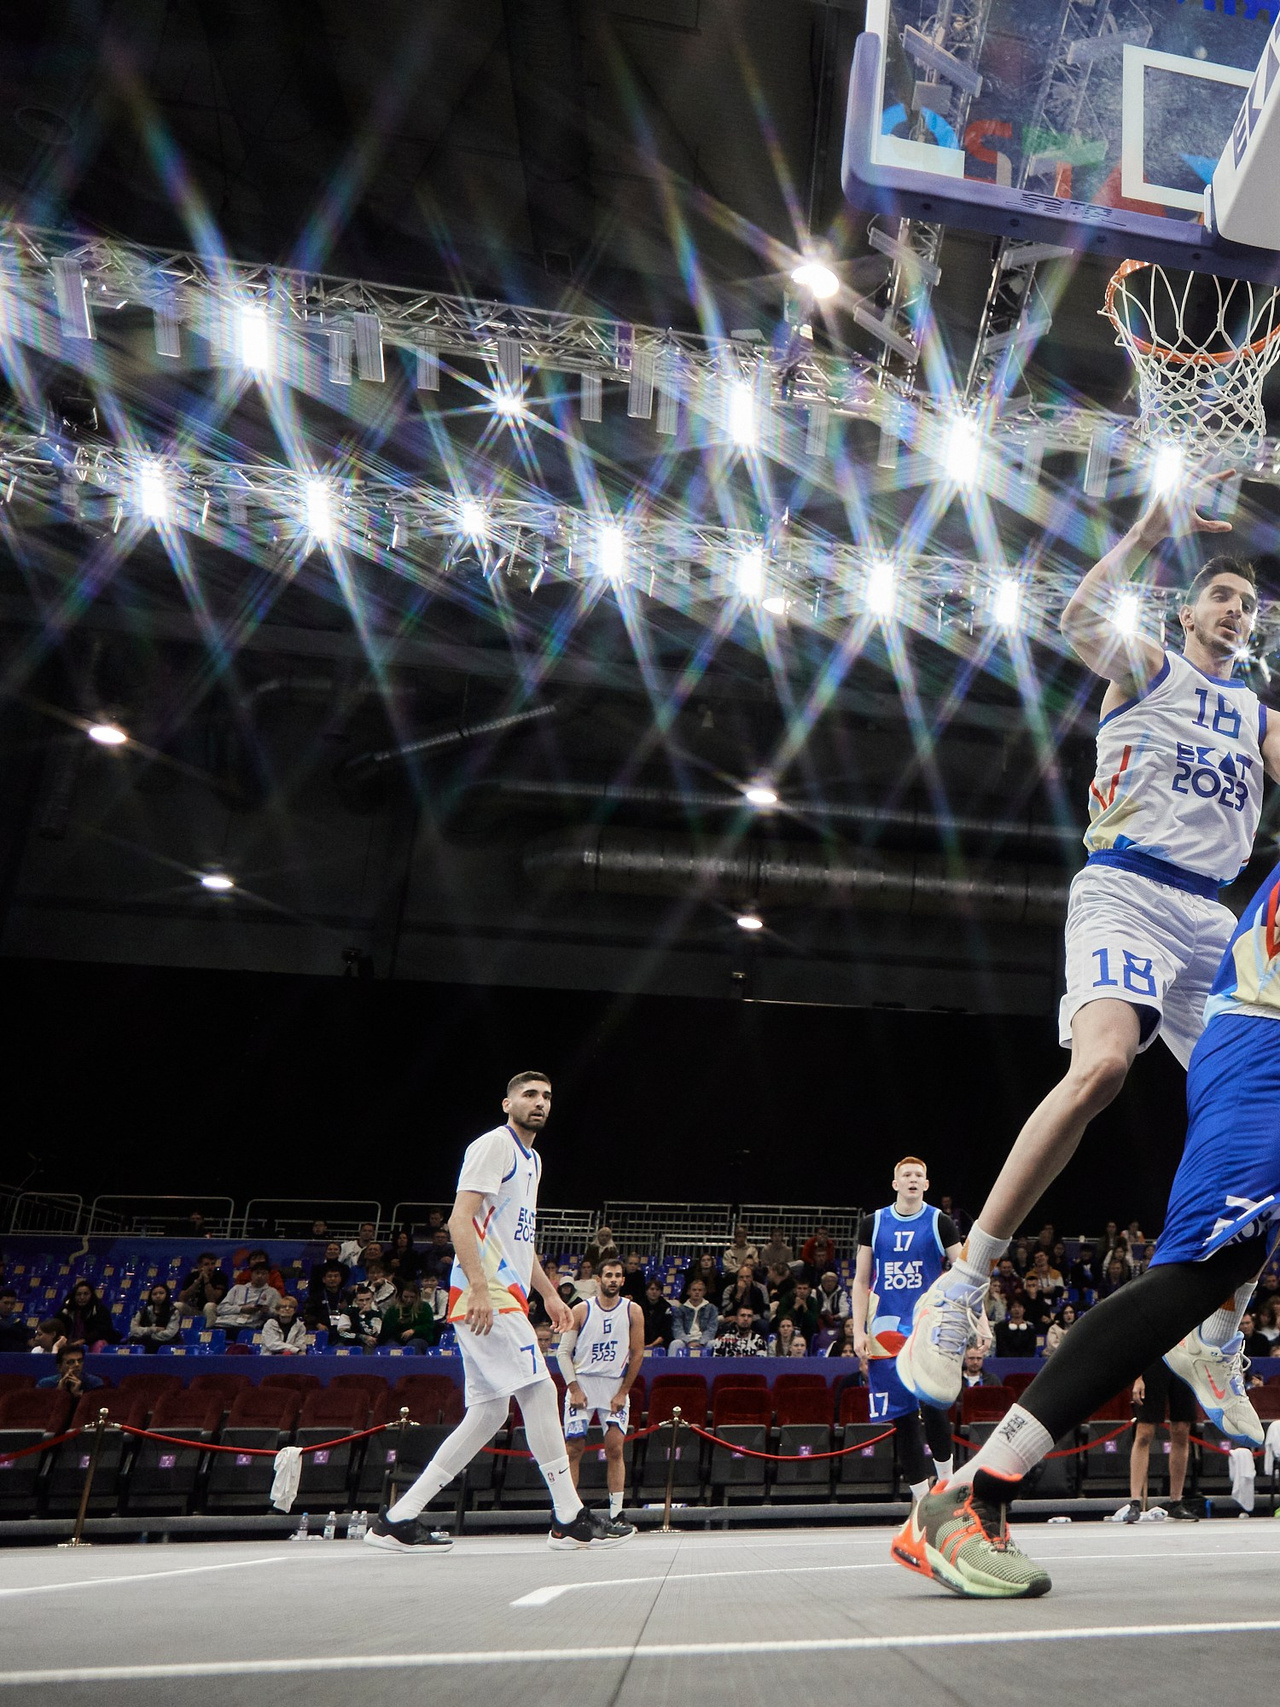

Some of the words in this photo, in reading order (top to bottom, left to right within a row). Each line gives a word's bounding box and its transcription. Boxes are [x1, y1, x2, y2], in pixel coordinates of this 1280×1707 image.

[1191, 687, 1242, 740] 18
[1171, 761, 1249, 812] 2023
[1091, 948, 1158, 998] 18
[893, 1231, 915, 1252] 17
[884, 1260, 923, 1275] EKAT
[884, 1273, 923, 1290] 2023
[603, 1319, 612, 1334] 6
[520, 1344, 537, 1375] 7
[868, 1392, 889, 1419] 17
